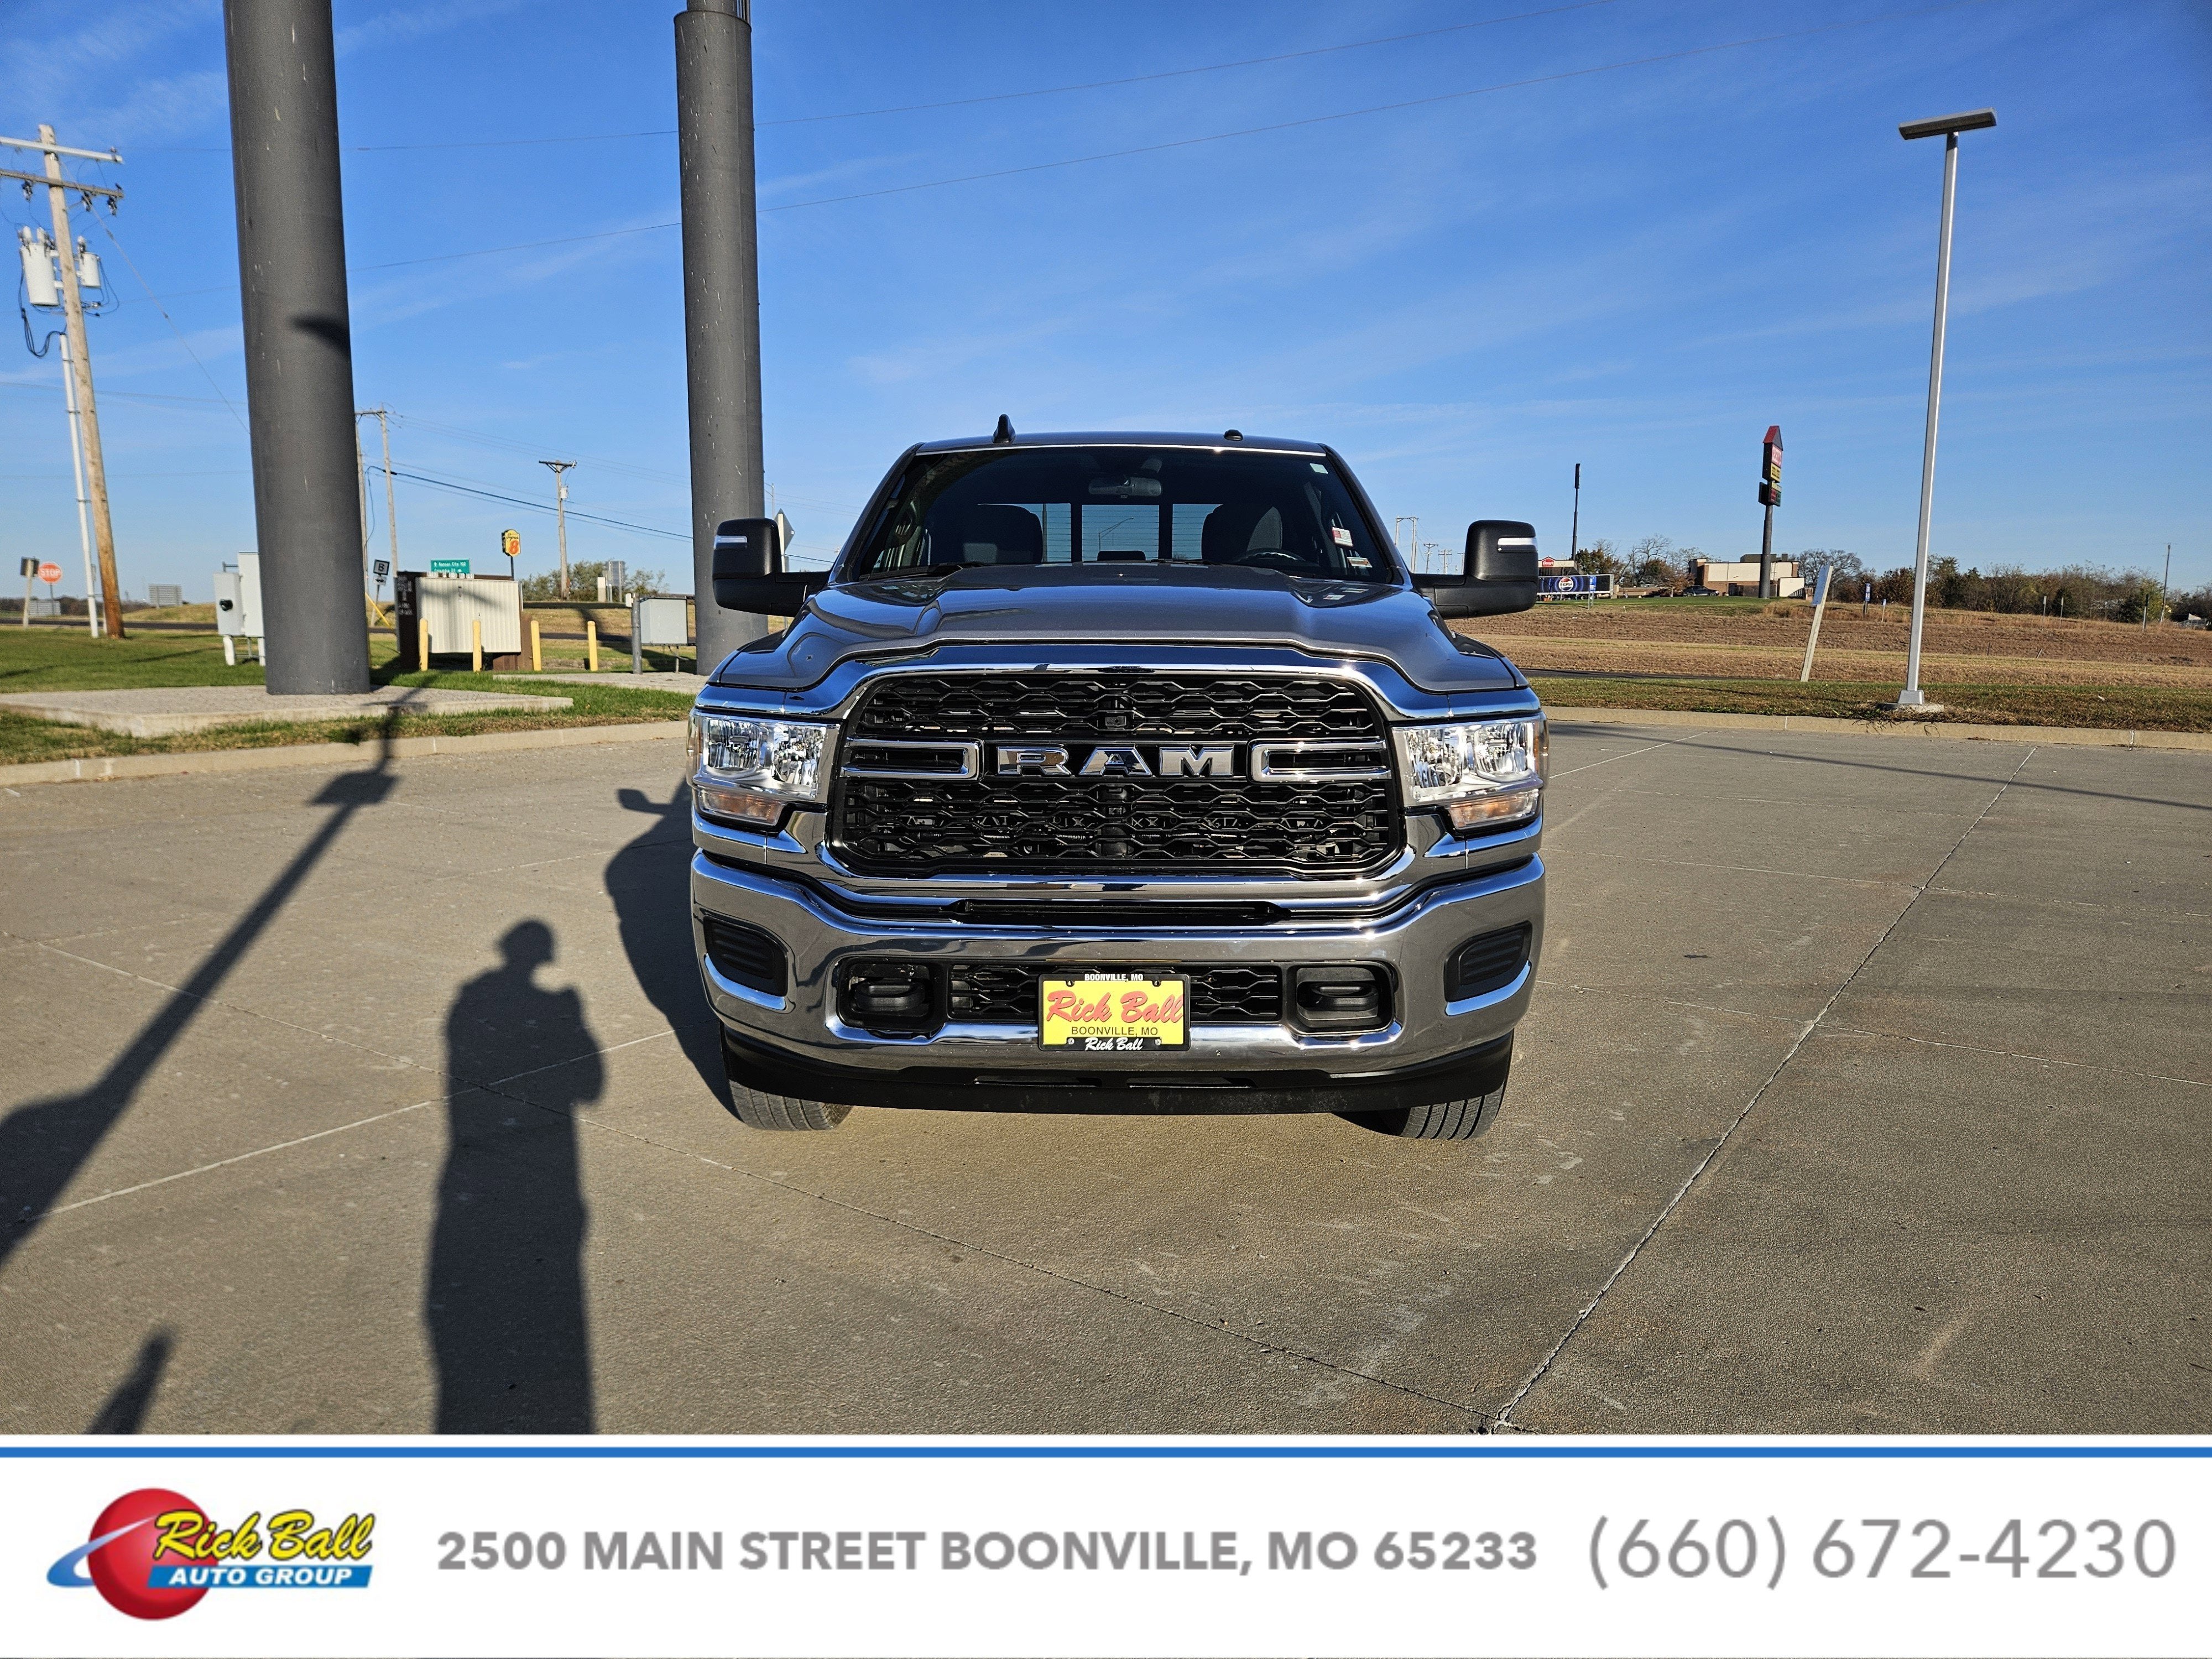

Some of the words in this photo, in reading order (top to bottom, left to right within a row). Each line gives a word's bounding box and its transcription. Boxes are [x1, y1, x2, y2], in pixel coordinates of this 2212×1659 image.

[509, 540, 519, 555] 8
[39, 568, 61, 578] STOP
[378, 563, 384, 571] B
[997, 745, 1234, 775] RAM
[1084, 973, 1129, 982] BOONVILLE,
[1046, 990, 1112, 1022] Rick
[1120, 990, 1183, 1023] Ball
[1071, 1026, 1138, 1037] BOONVILLE,
[1141, 1027, 1159, 1036] MO
[1084, 1037, 1114, 1051] Rick
[1116, 1037, 1144, 1051] Ball
